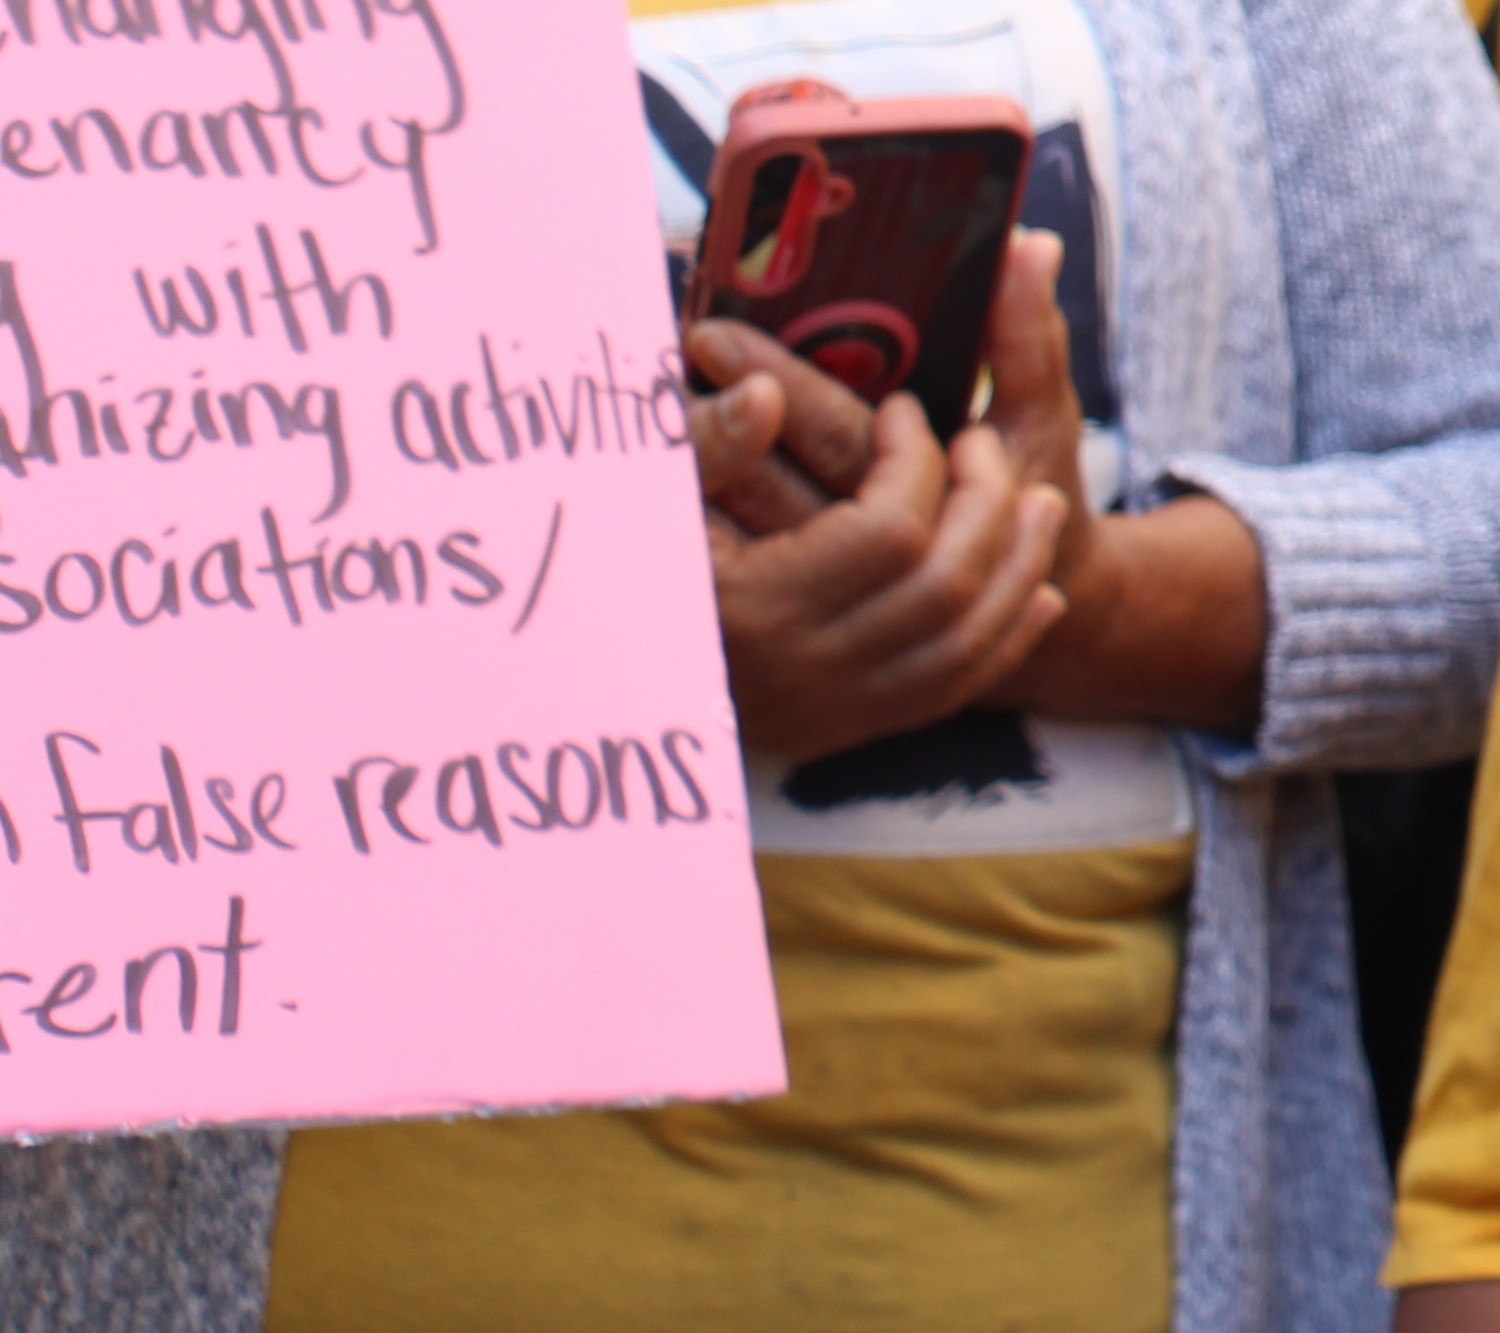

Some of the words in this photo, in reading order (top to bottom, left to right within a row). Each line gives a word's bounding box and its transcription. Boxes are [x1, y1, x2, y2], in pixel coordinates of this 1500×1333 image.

[132, 222, 393, 355] with
[45, 731, 298, 874] false
[334, 730, 711, 855] reasons
